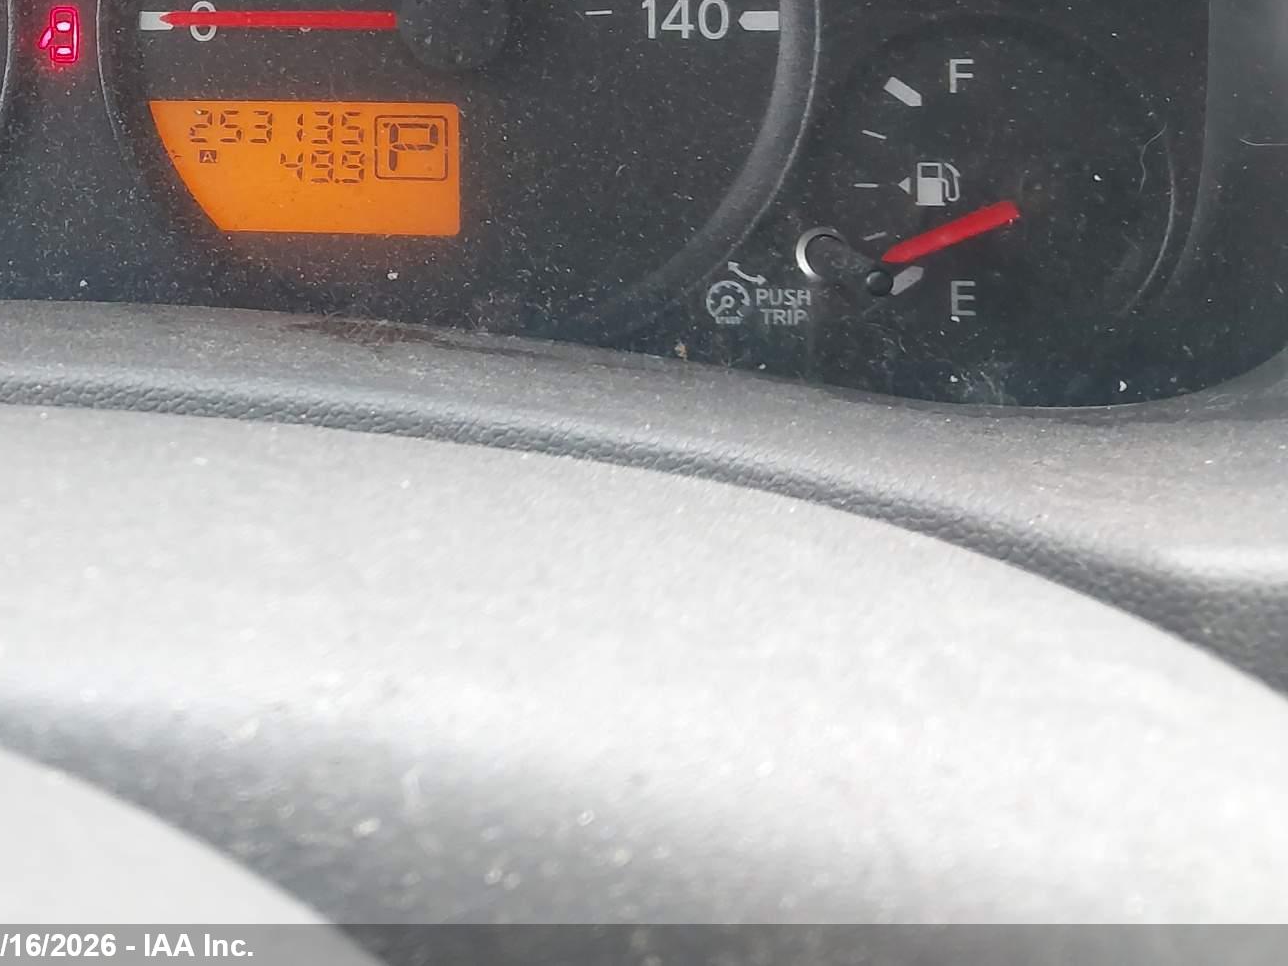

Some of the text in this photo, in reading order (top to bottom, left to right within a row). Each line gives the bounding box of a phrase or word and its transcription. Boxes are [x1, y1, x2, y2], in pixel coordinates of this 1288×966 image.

[949, 58, 974, 94] F
[189, 108, 365, 145] 253135
[382, 122, 438, 172] P
[756, 288, 812, 308] PUSH
[950, 280, 977, 317] E
[760, 308, 810, 326] TRIP
